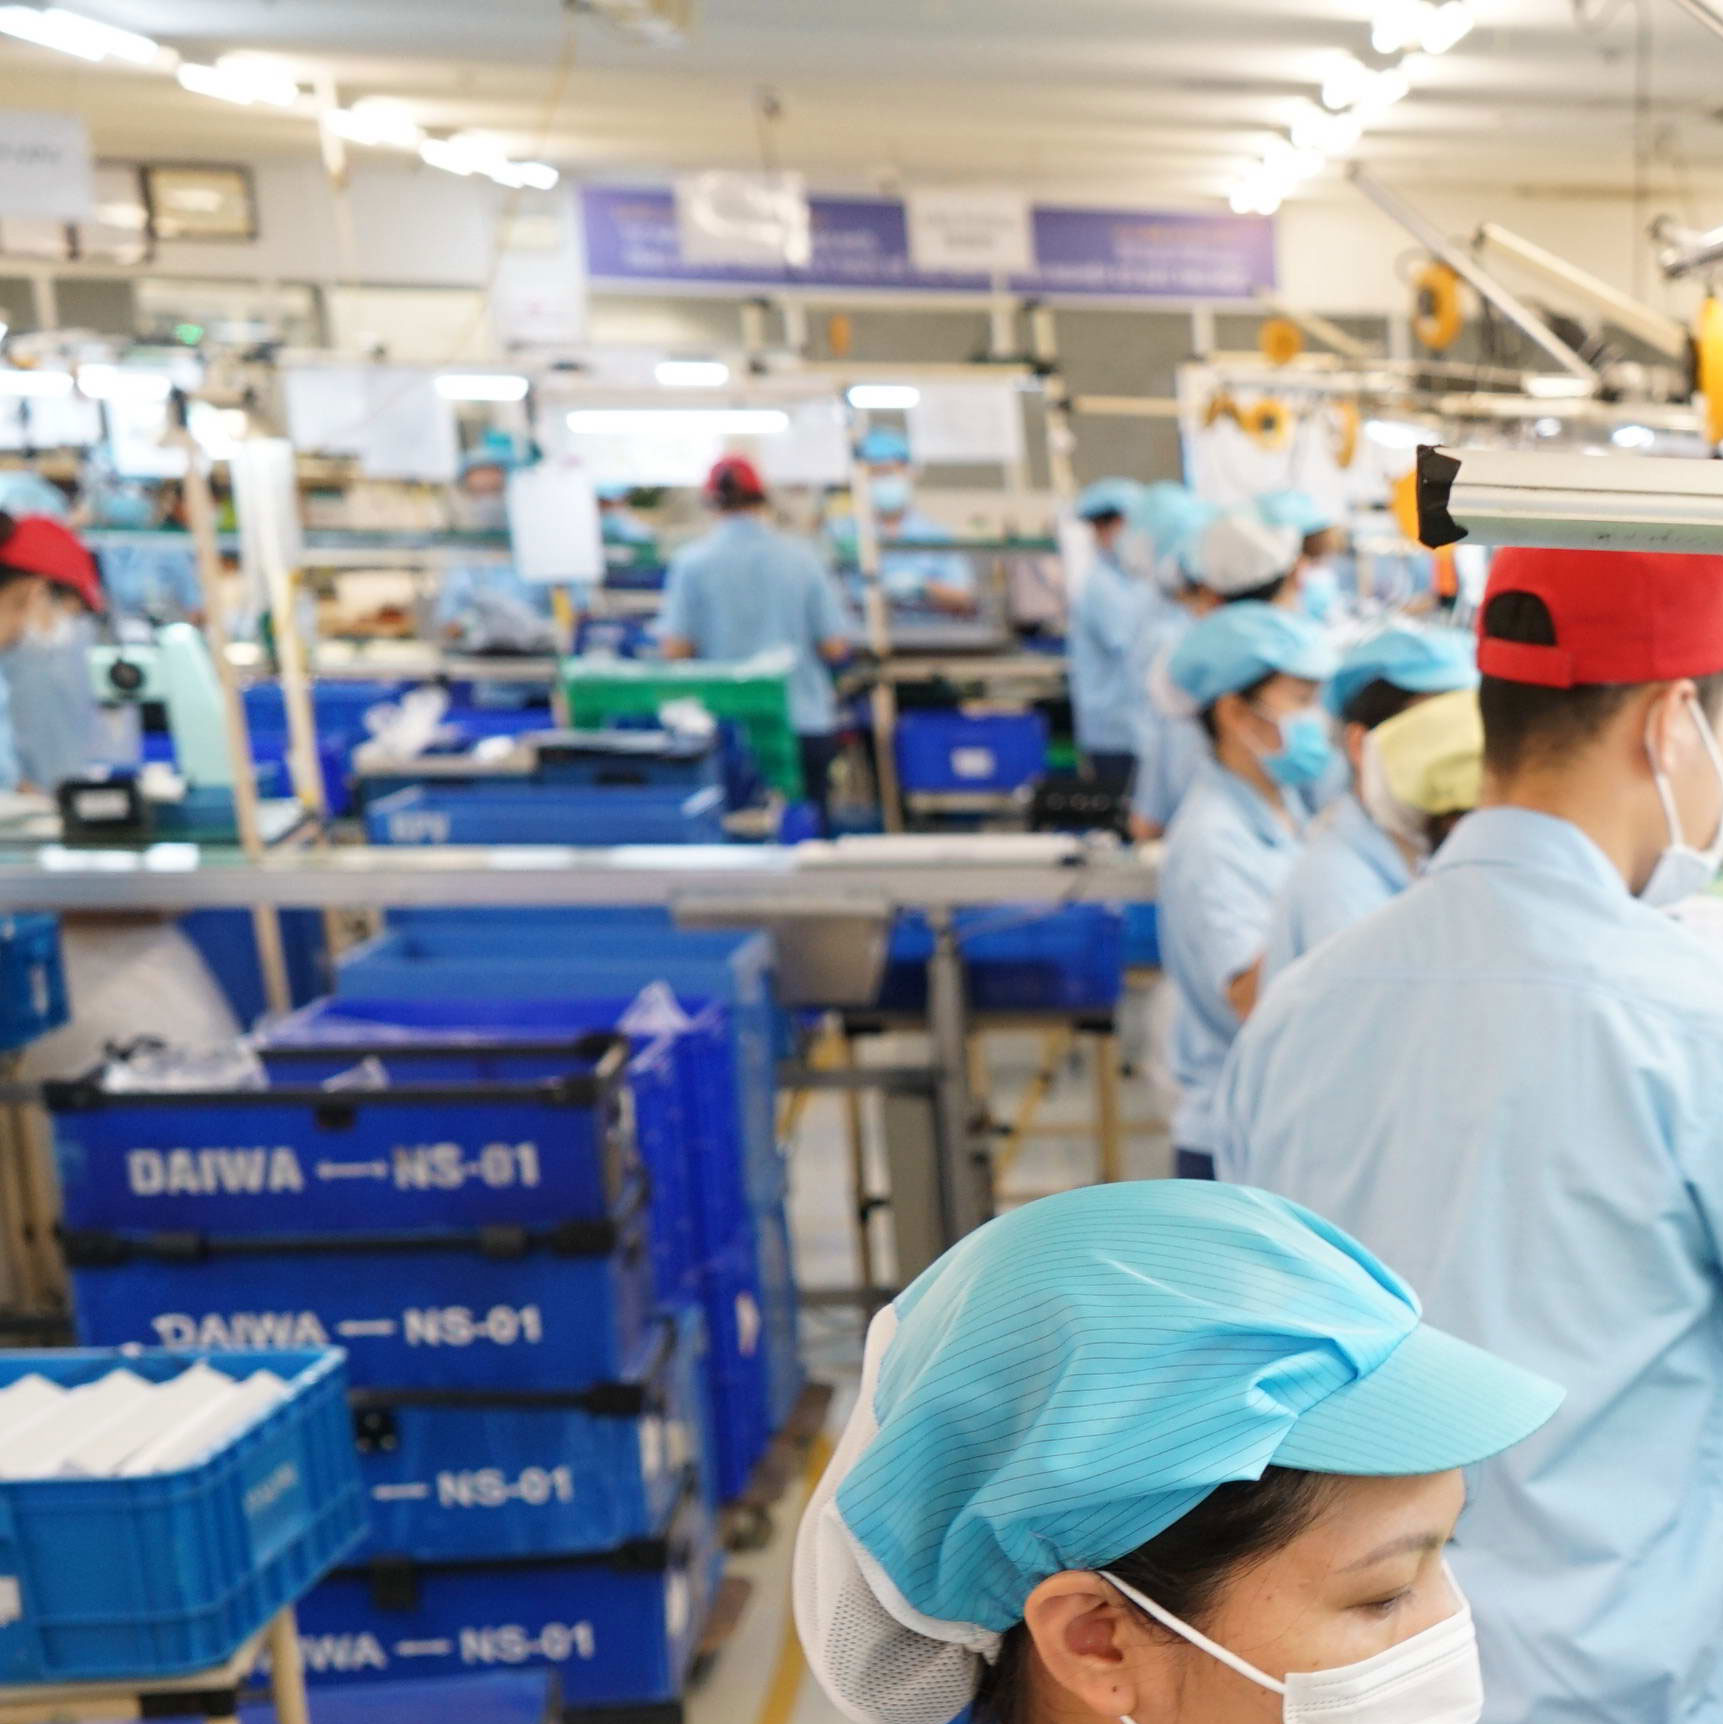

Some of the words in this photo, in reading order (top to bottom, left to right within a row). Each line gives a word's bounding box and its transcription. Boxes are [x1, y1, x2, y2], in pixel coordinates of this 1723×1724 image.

[127, 1146, 304, 1196] DAIWA
[392, 1142, 541, 1191] NS-01
[151, 1310, 330, 1348] DAIWA
[403, 1303, 542, 1346] NS-01
[436, 1465, 574, 1508] NS-01
[459, 1620, 595, 1665] NS-01
